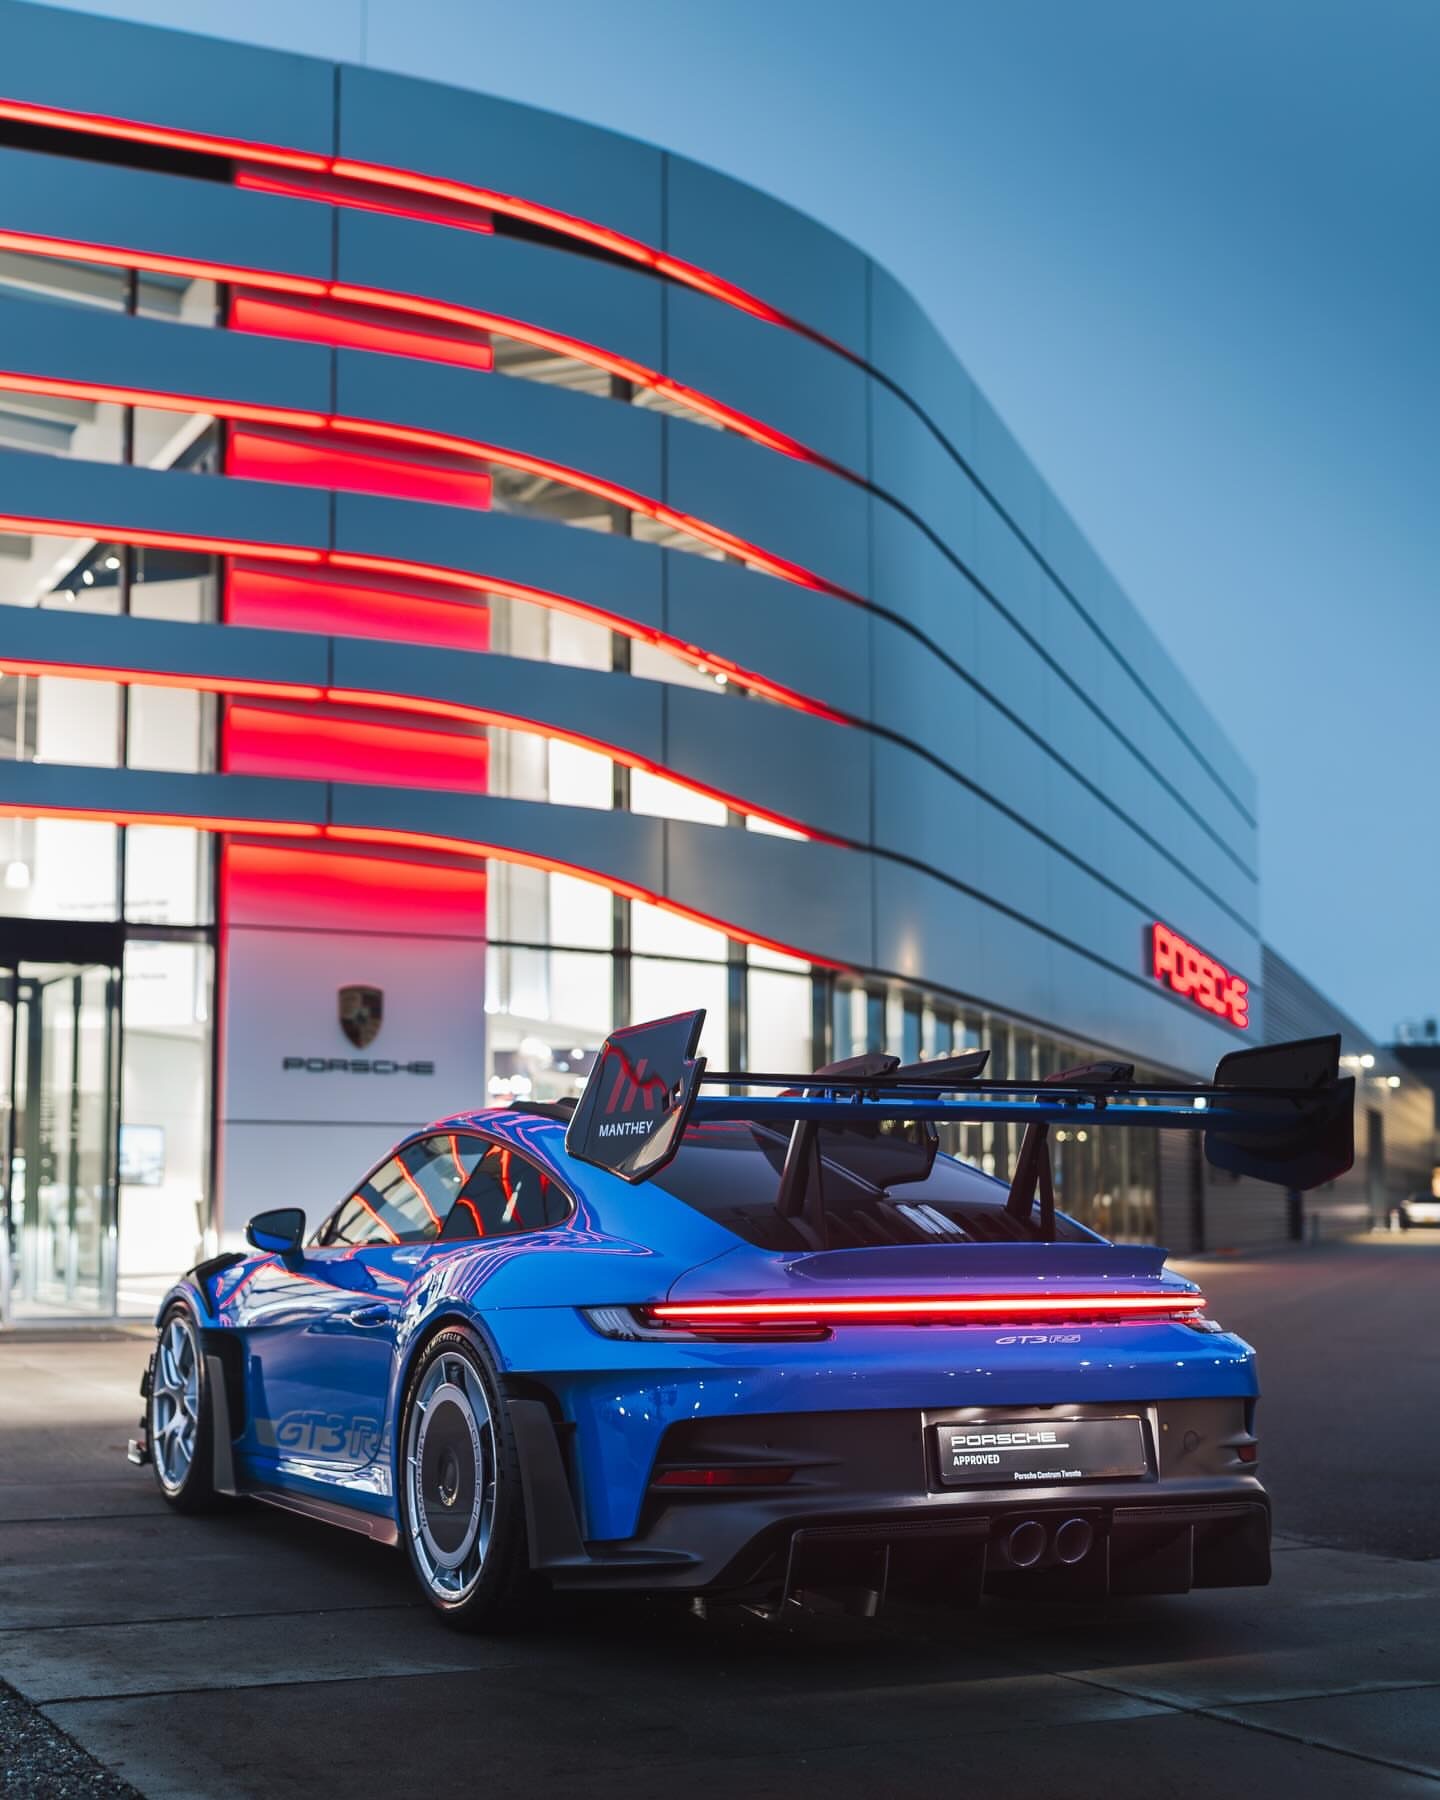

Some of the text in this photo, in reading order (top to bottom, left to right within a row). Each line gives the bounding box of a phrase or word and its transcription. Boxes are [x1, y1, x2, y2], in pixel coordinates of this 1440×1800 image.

[1152, 921, 1249, 1029] PORSCHE
[283, 1057, 434, 1075] PORSCHE
[599, 1120, 654, 1137] MANTHEY
[951, 1432, 1057, 1446] PORSCHE
[953, 1454, 1000, 1466] APPROVED
[1014, 1471, 1037, 1480] Porsche
